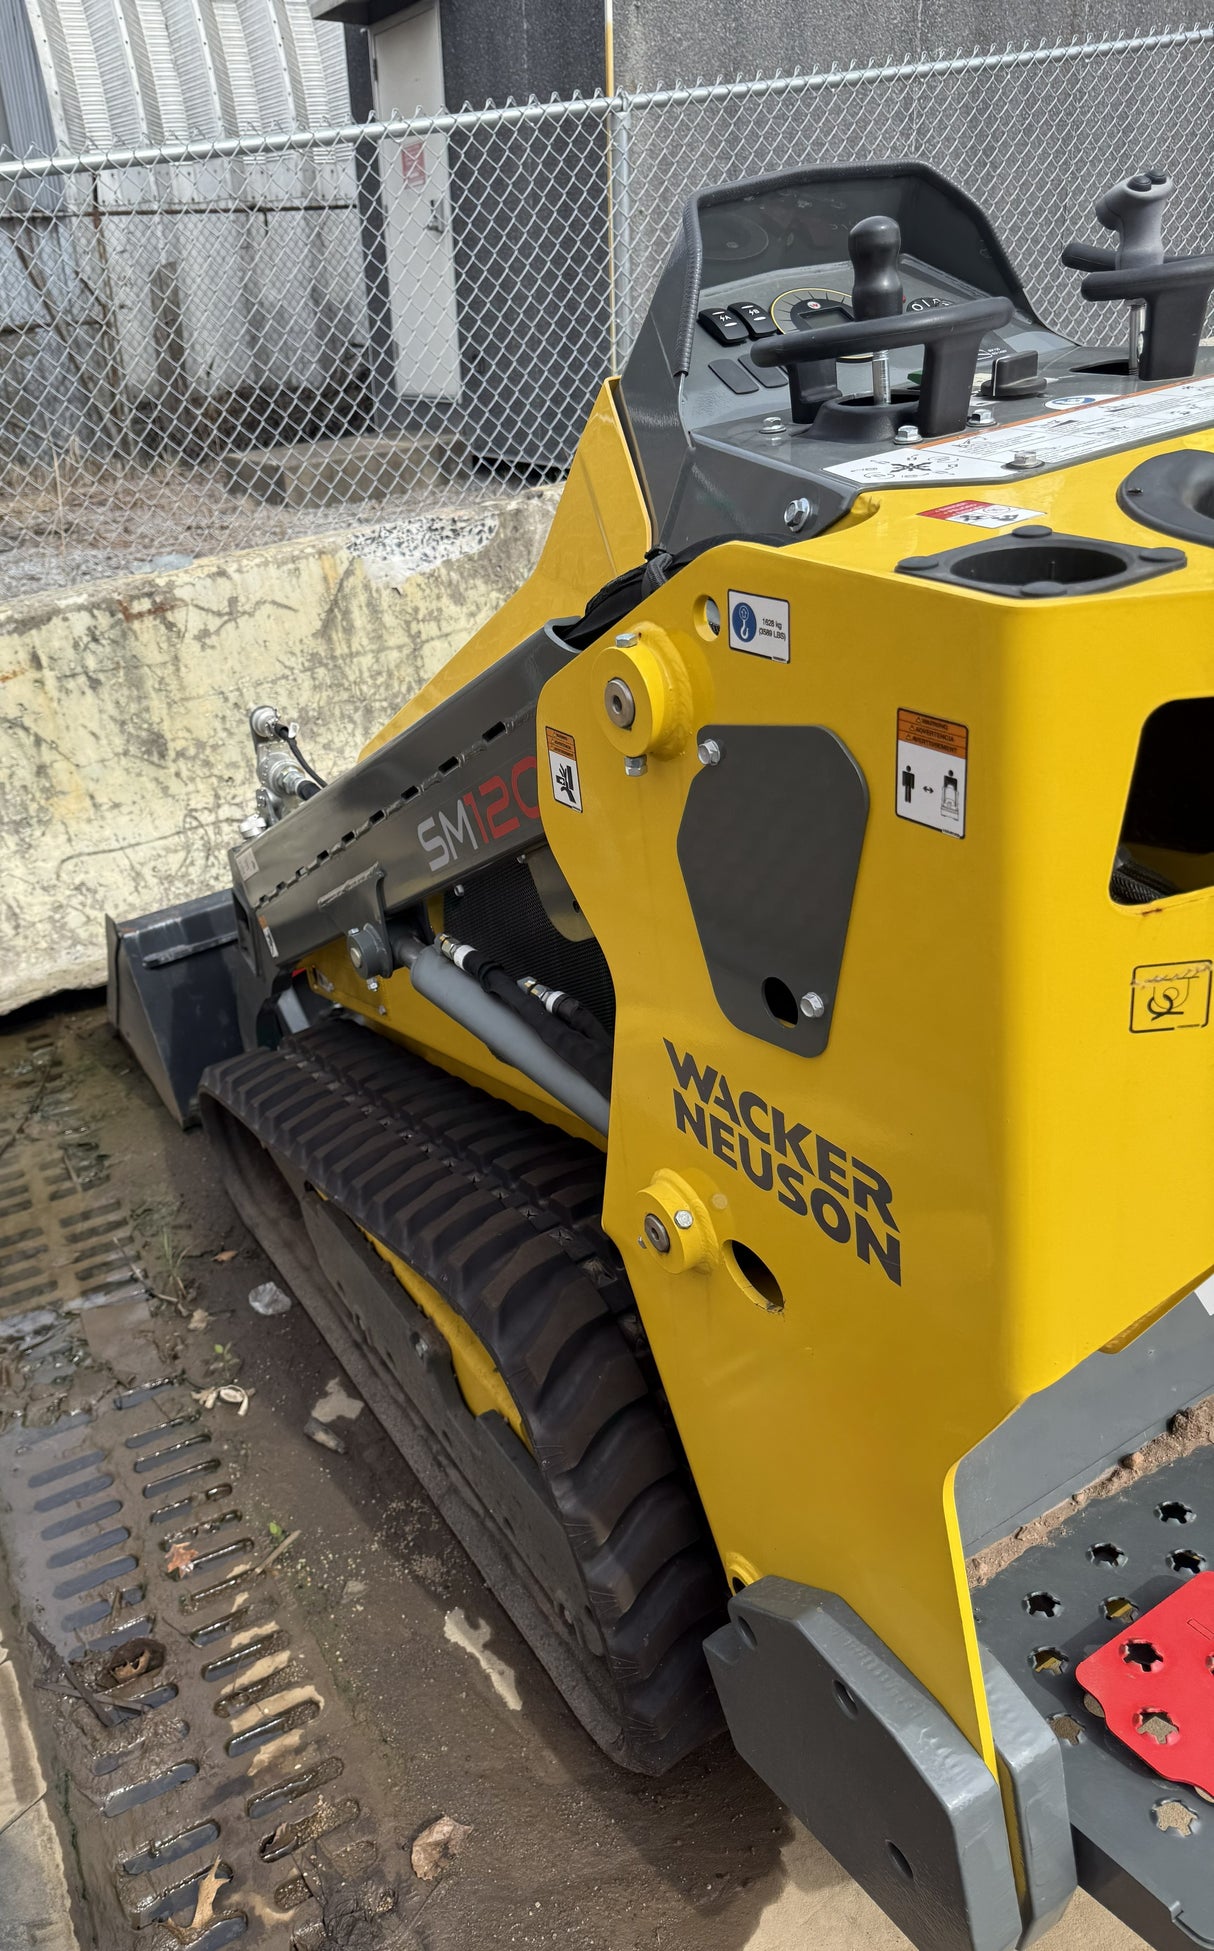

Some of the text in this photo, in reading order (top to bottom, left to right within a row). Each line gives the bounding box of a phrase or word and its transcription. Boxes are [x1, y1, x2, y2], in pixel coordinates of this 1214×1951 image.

[775, 621, 782, 630] kg
[417, 755, 540, 872] SM120
[662, 1036, 901, 1234] WACKER
[672, 1087, 902, 1288] NEUSON
